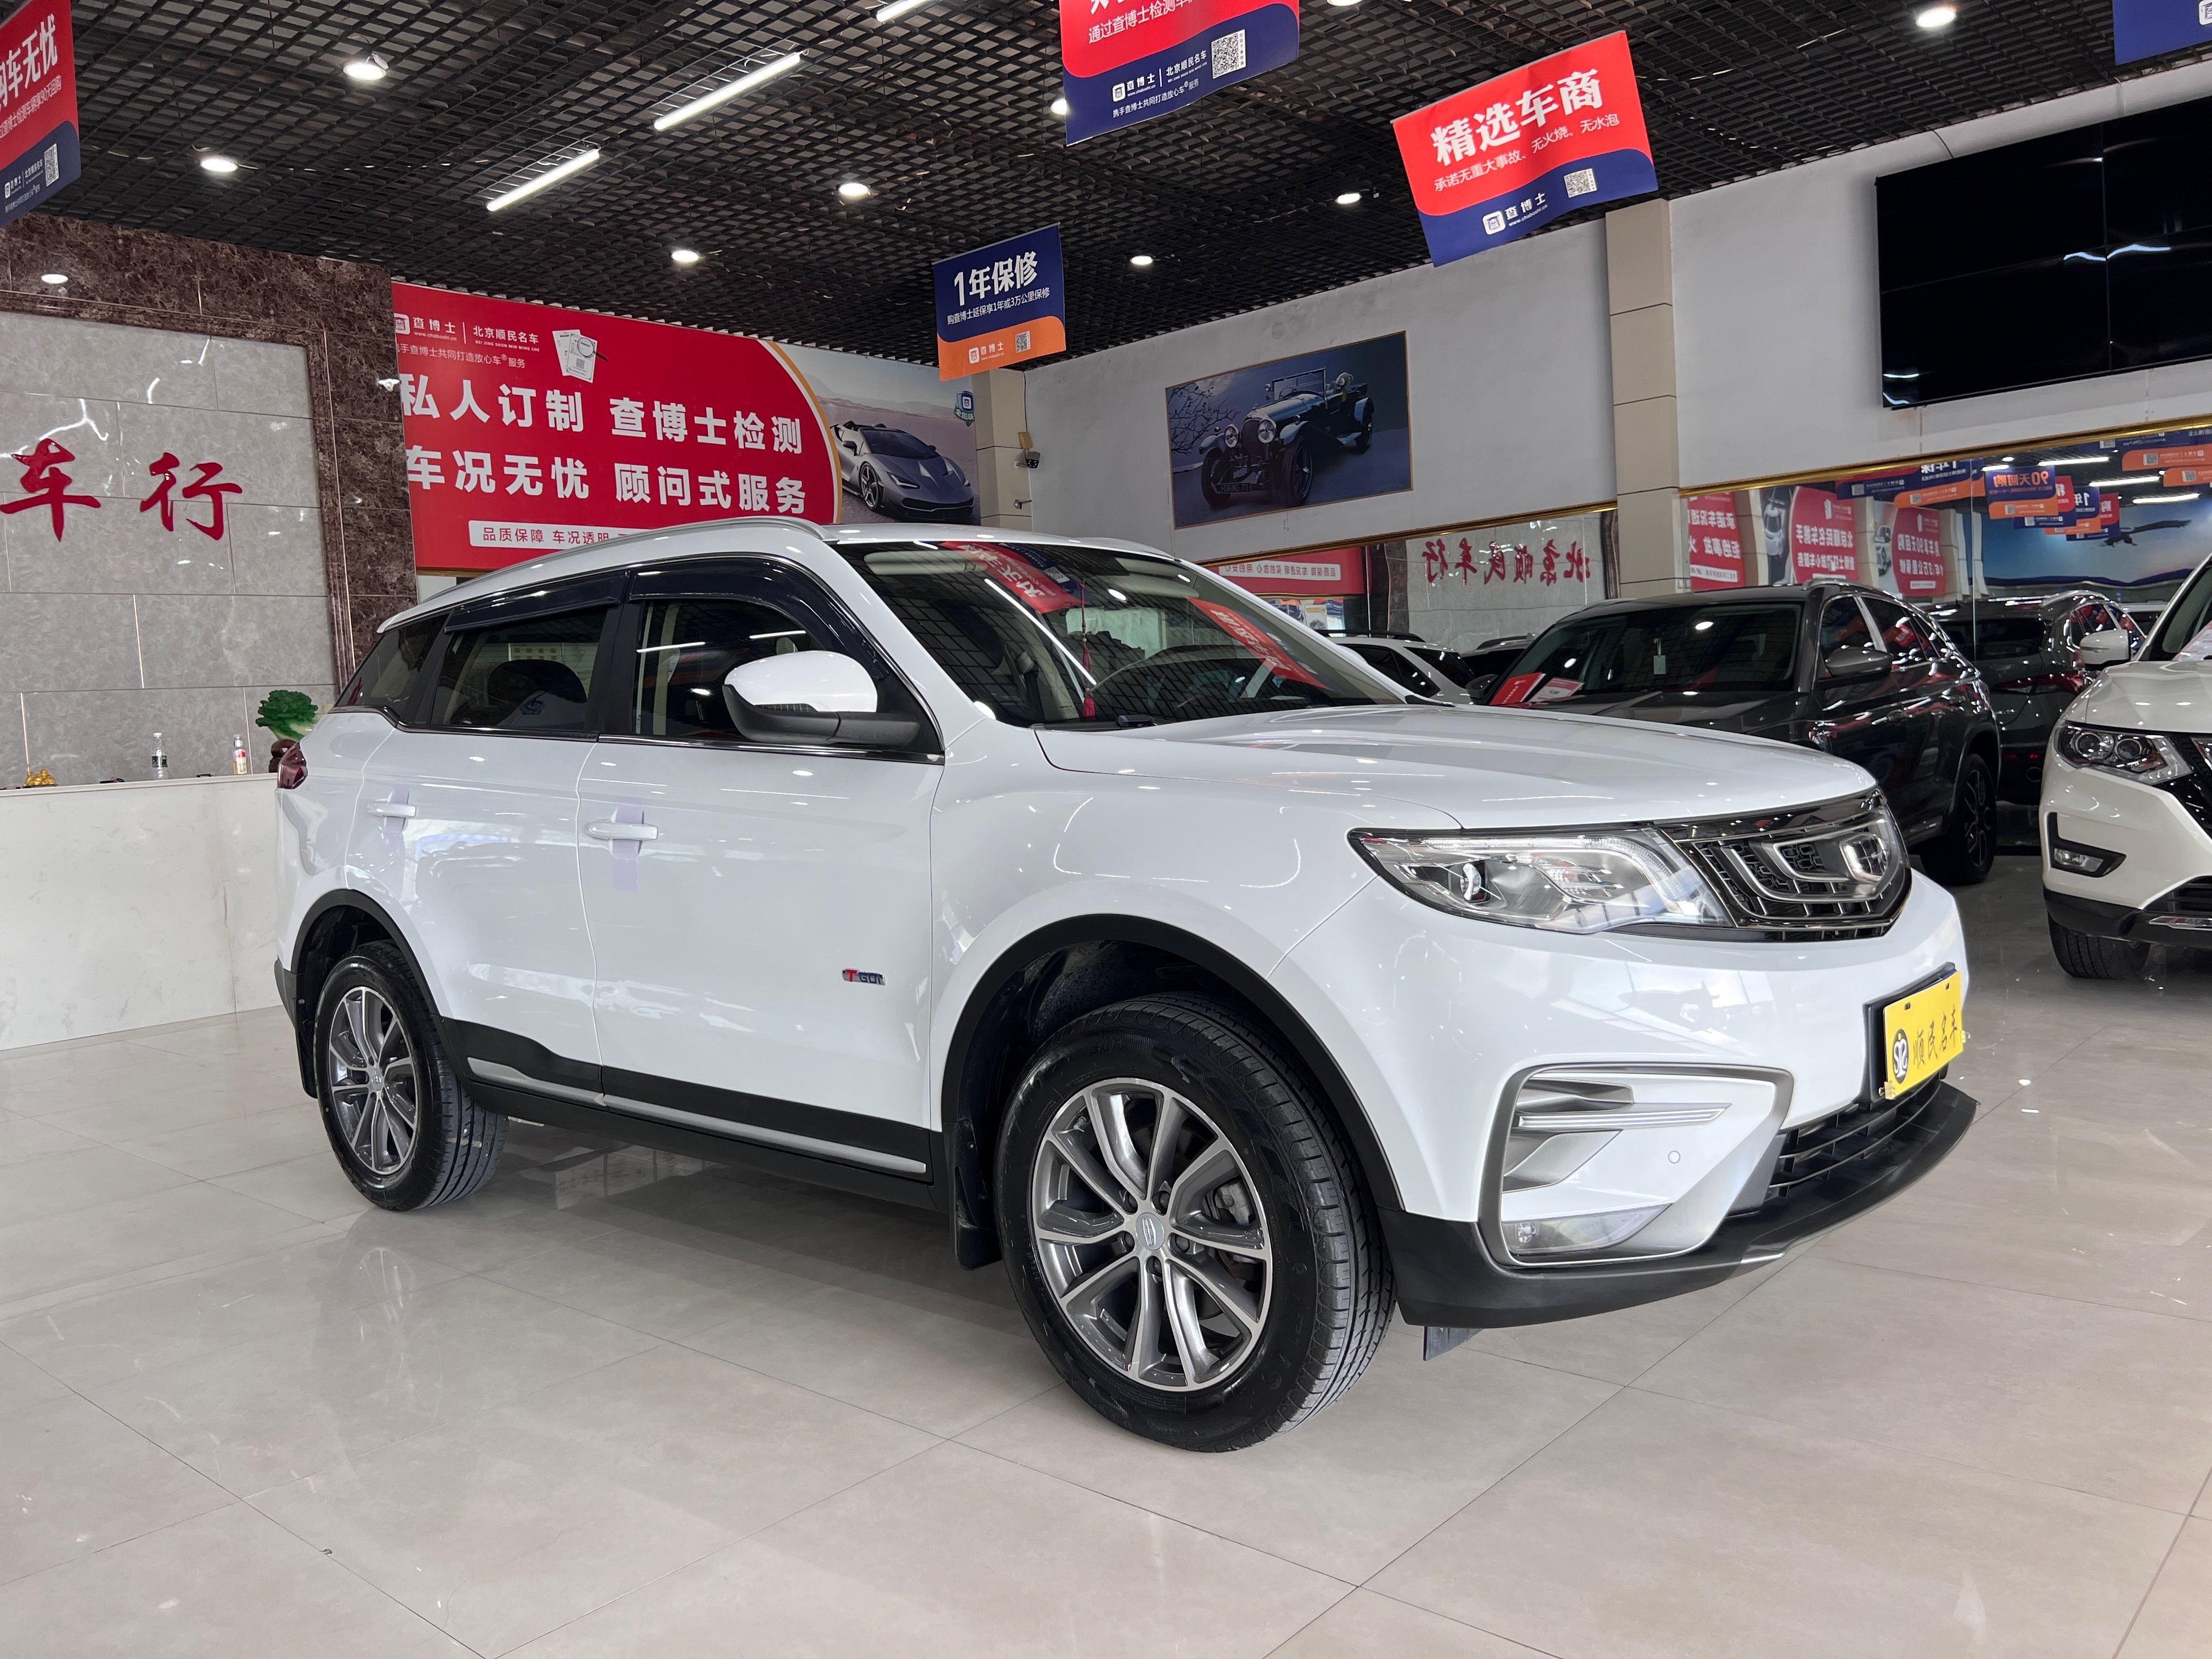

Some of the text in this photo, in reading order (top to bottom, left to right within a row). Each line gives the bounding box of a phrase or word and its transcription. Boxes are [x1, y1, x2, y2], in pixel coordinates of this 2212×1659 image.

[1127, 73, 1155, 92] 查博士
[1166, 50, 1207, 77] 北京顺民名车
[1430, 68, 1603, 166] 精选车商
[1505, 193, 1547, 220] 查博士
[954, 251, 1038, 306] 1年保修
[947, 287, 1050, 325] 购查博士延保享1年或3万公里保修
[413, 317, 456, 334] 查博士
[473, 326, 539, 345] 北京顺民名车
[414, 331, 457, 341] www.chaboshi.cn
[980, 341, 1005, 356] 查博士
[400, 373, 803, 454] 私人订制 查博士检测
[0, 438, 242, 542] 车行
[405, 444, 806, 515] 车况无忧 顾问式服务
[483, 527, 610, 545] 品质保障 车况透明
[1913, 1004, 1957, 1070] 顺民名车
